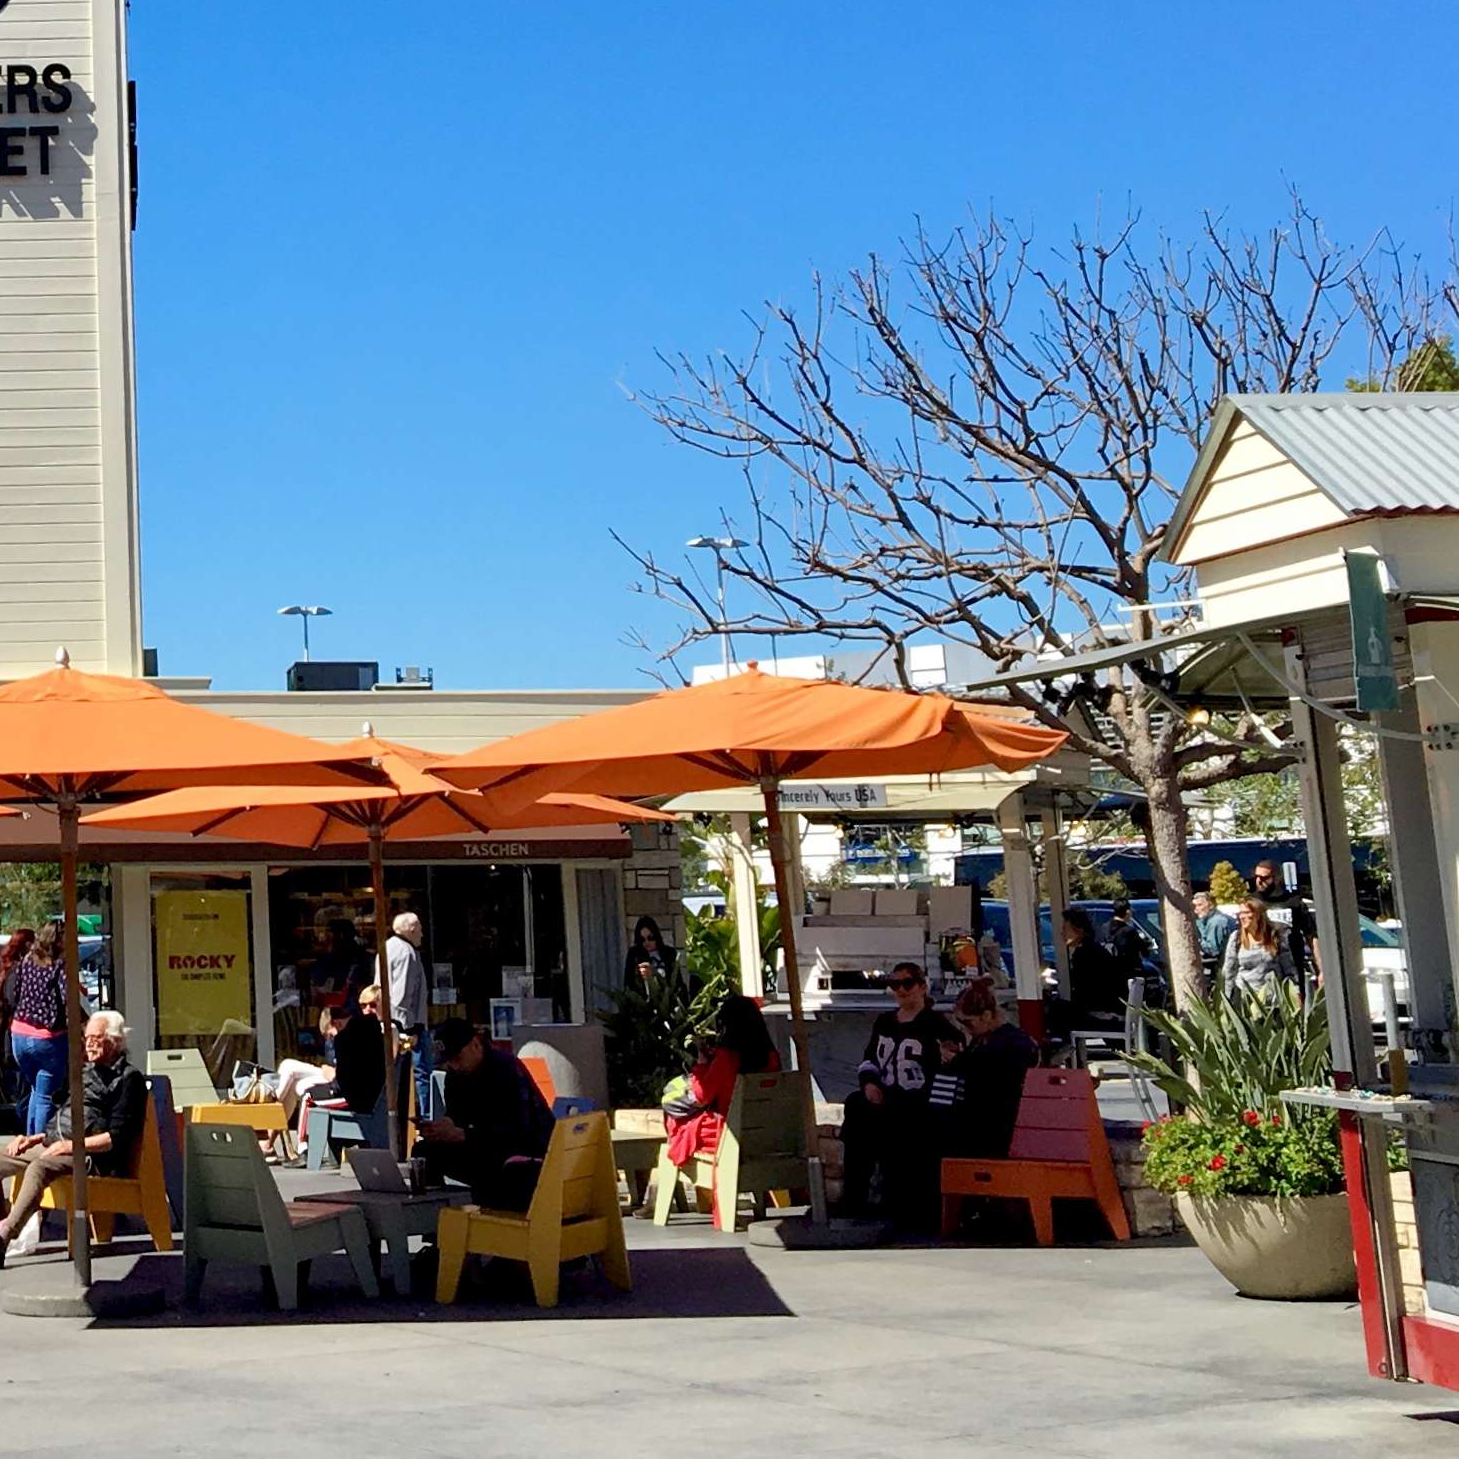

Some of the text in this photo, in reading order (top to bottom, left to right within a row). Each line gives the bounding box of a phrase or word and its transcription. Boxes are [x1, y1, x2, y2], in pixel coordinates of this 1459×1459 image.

[825, 789, 852, 802] Yours
[854, 788, 877, 802] USA
[462, 843, 529, 856] TASCHEN
[168, 954, 236, 970] ROCKY
